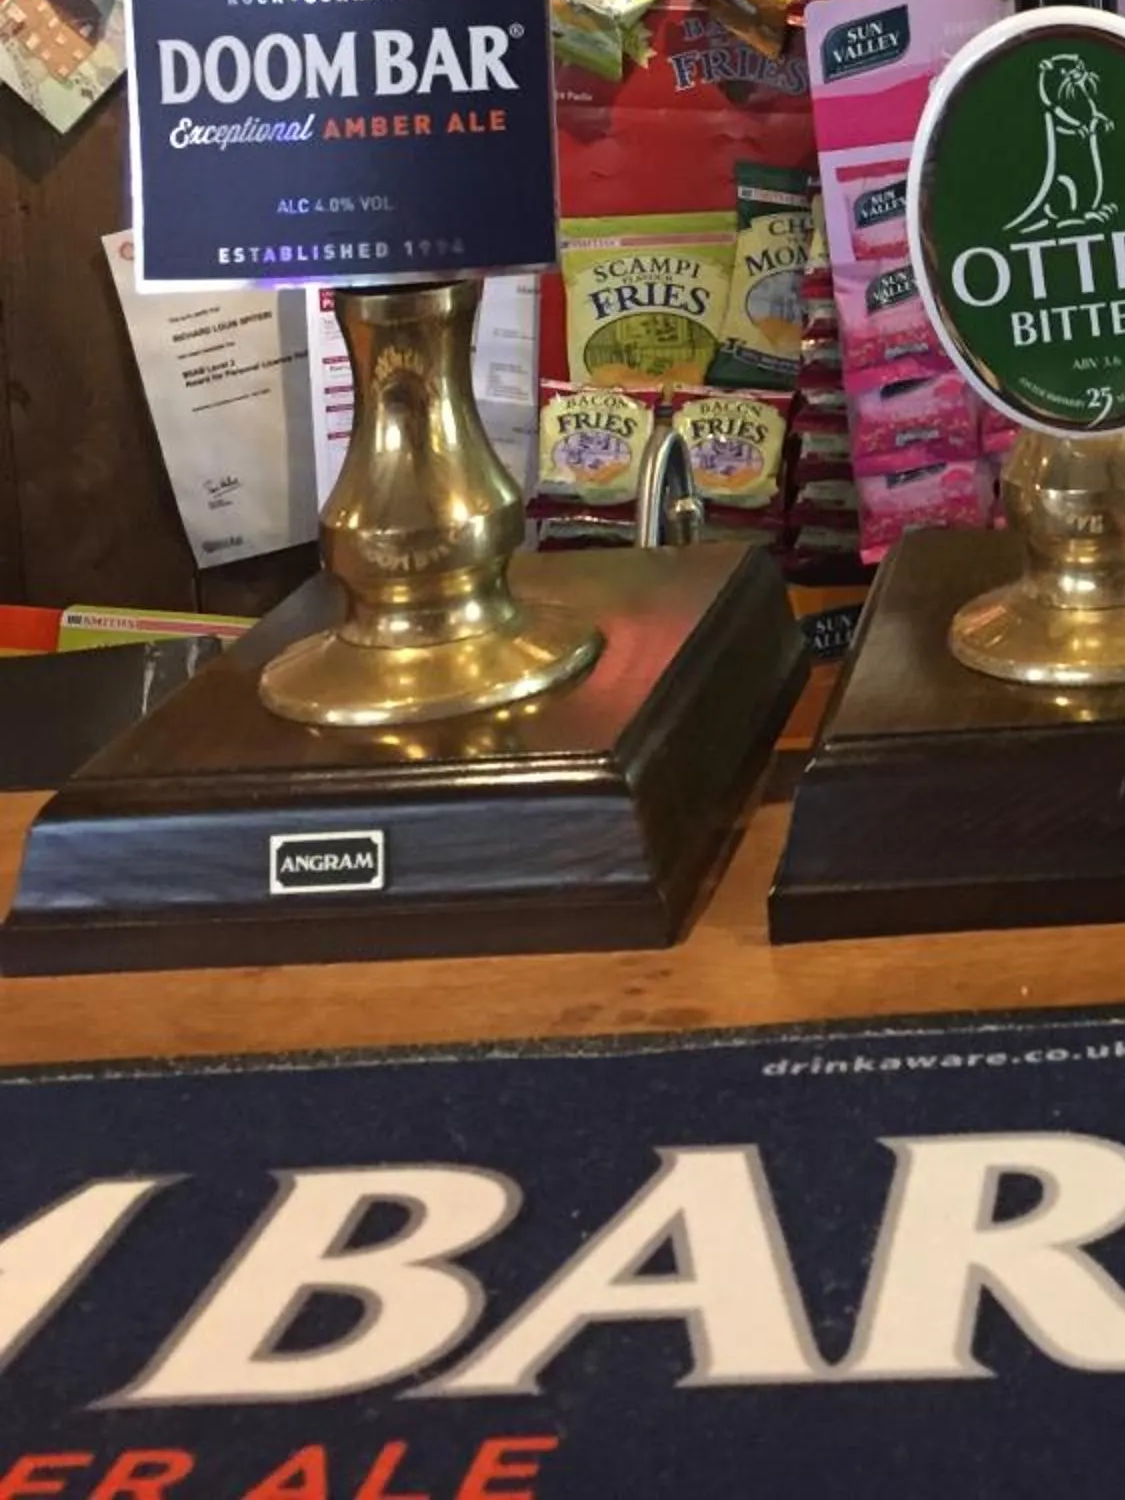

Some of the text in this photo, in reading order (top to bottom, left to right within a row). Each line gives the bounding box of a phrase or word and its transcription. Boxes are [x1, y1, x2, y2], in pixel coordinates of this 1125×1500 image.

[846, 19, 886, 44] SUN
[832, 29, 901, 64] VALLEY
[158, 33, 359, 105] DOOM
[169, 110, 508, 151] Exceptional AMBER ALE
[276, 198, 310, 214] ALC
[218, 240, 390, 265] ESTABLISHED
[592, 256, 700, 284] SCAMPI
[587, 281, 712, 320] FRIES
[556, 411, 639, 439] FRIES
[690, 417, 769, 444] FRIES
[279, 851, 375, 874] ANGRAM
